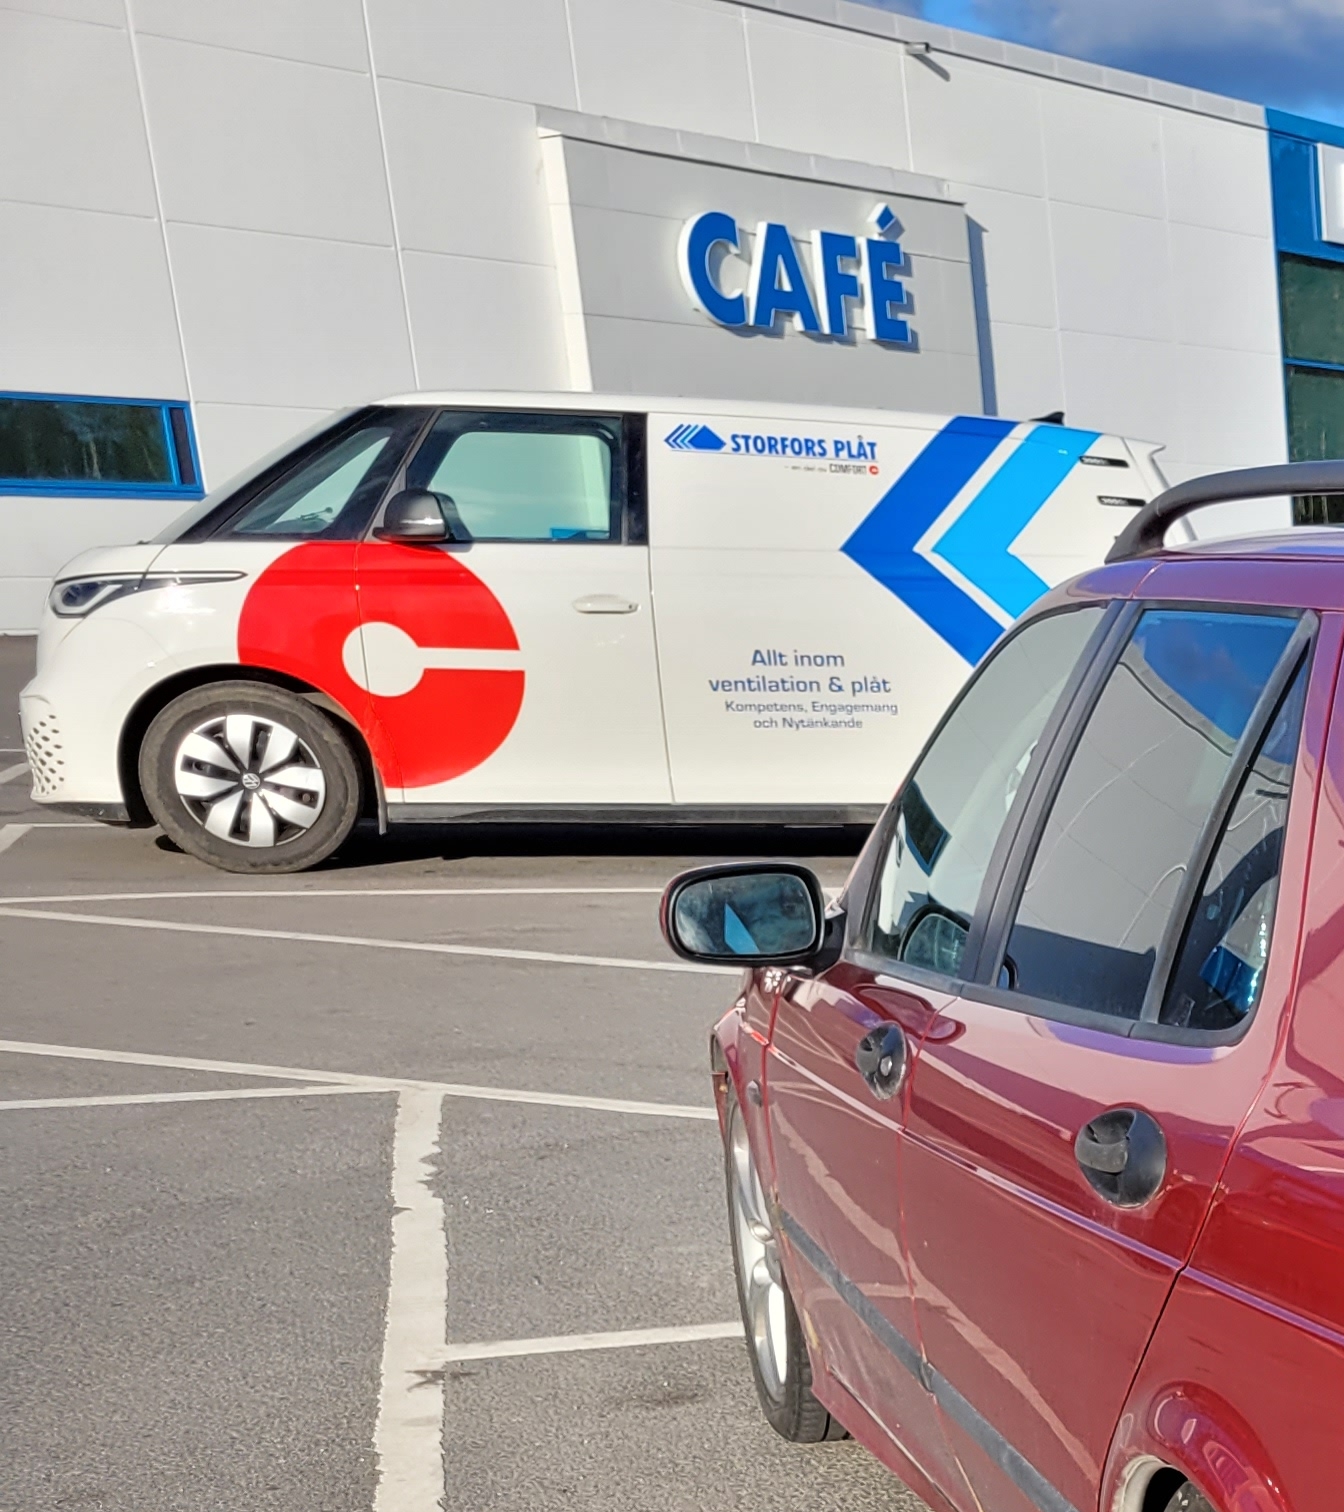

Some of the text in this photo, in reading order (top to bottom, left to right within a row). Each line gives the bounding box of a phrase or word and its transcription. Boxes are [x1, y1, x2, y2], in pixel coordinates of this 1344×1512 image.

[677, 201, 913, 344] CAFÉ
[730, 433, 878, 462] STORFORS PLÅT
[751, 648, 846, 668] Allt inom
[708, 675, 892, 698] ventilation & plåt
[724, 700, 899, 716] Kompetens, Engagemang
[753, 717, 863, 731] och Nytänkande
